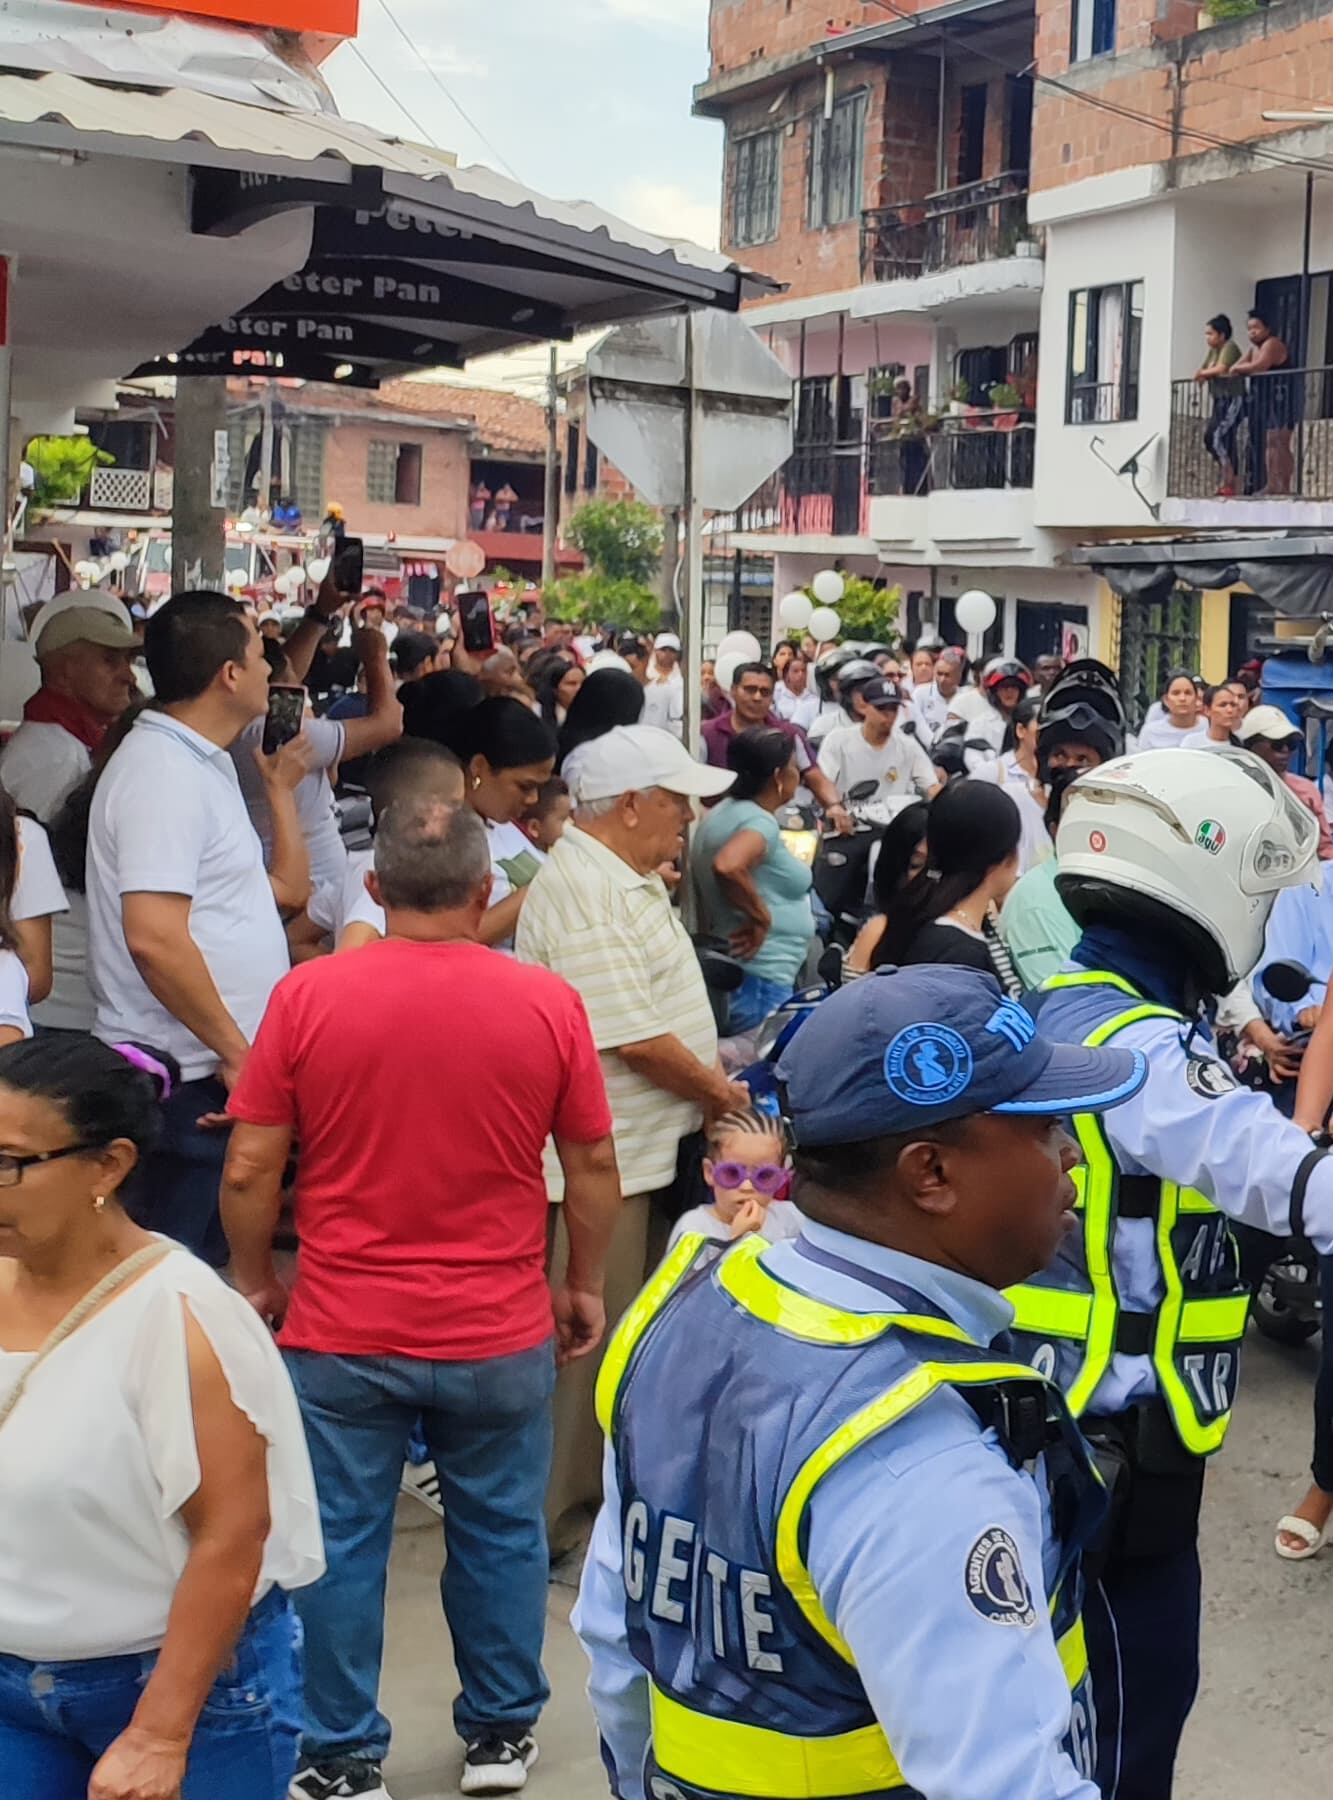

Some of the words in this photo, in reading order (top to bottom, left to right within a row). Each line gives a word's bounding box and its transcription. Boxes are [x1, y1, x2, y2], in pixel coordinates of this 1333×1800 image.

[283, 271, 364, 297] eter
[373, 275, 441, 304] Pan
[221, 316, 288, 338] eter
[296, 318, 354, 342] Pan
